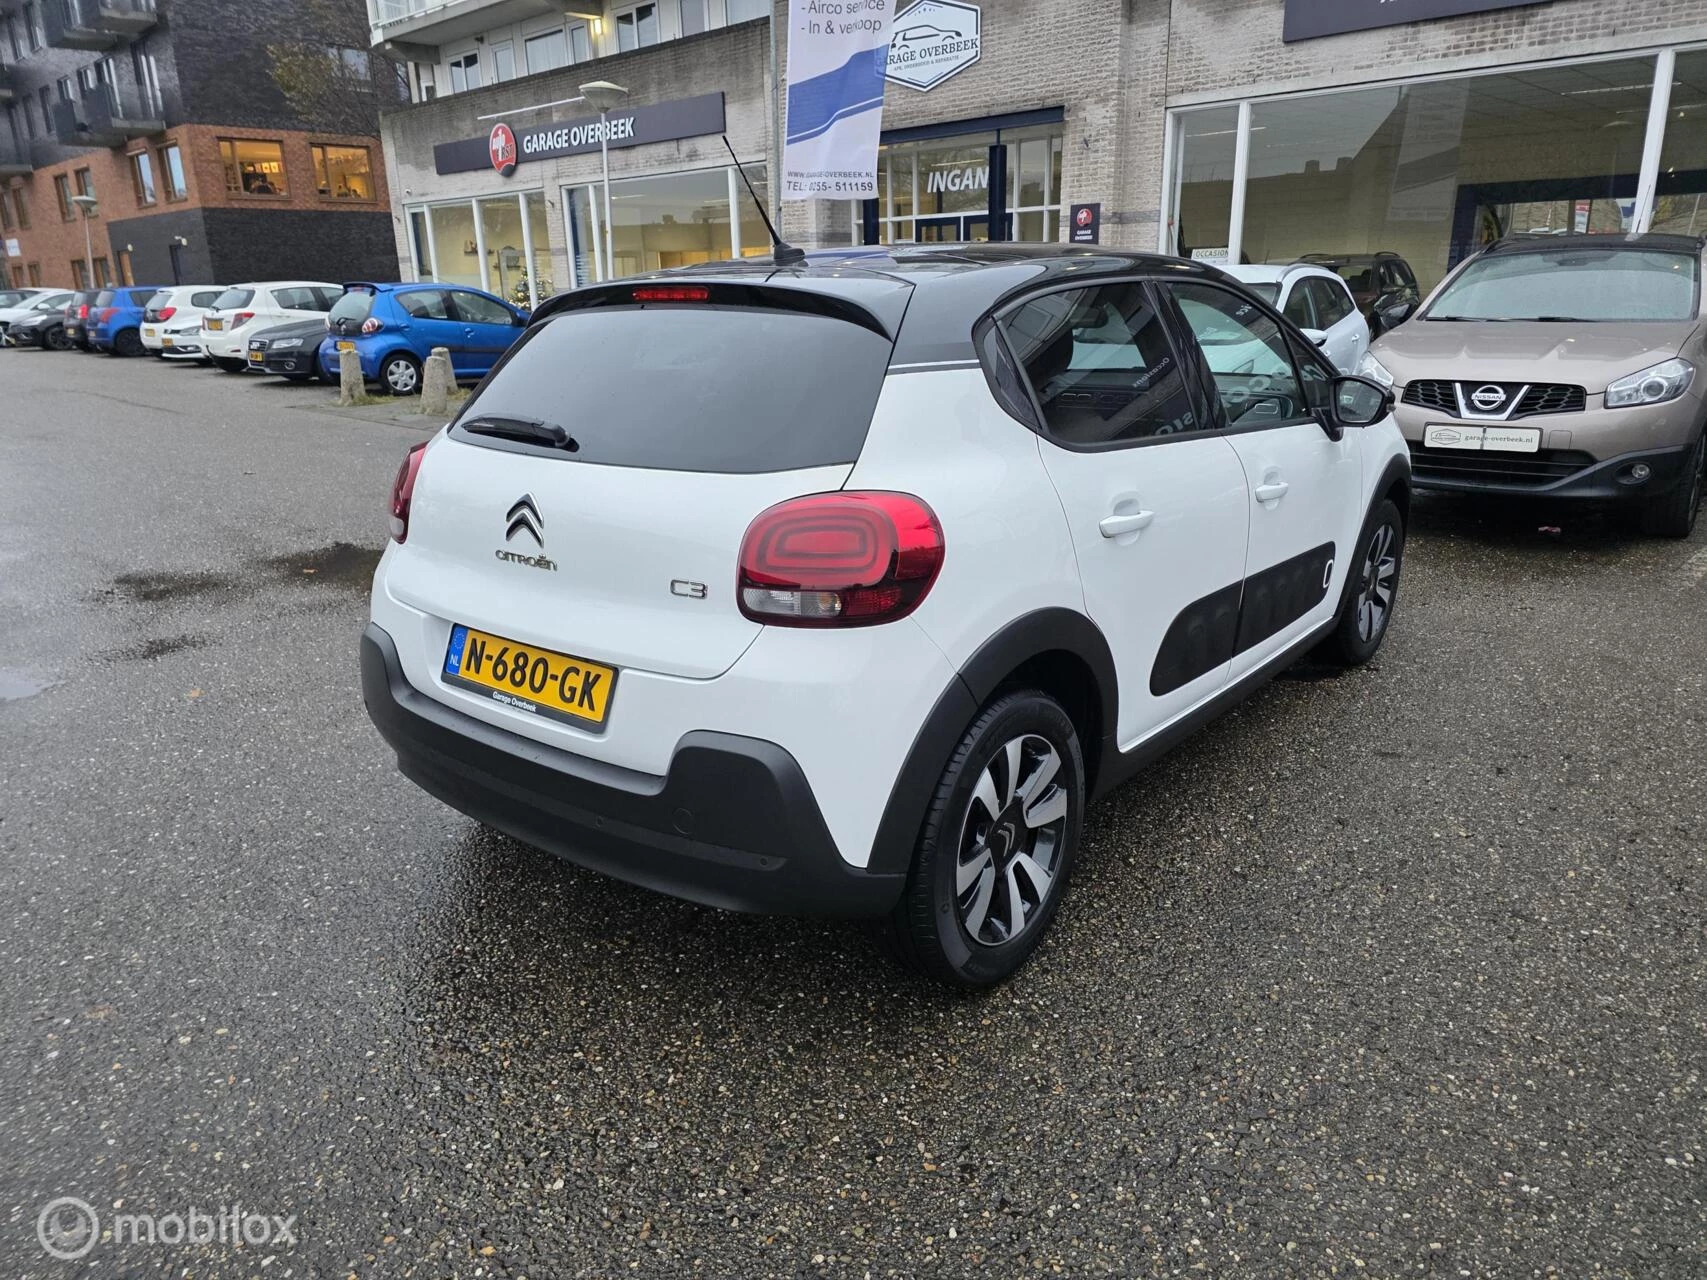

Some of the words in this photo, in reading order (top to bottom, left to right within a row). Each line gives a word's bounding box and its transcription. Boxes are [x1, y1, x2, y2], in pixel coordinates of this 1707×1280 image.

[808, 0, 842, 14] Airco
[809, 20, 820, 34] In
[824, 20, 834, 34] &
[887, 50, 917, 65] RAGE
[919, 38, 979, 59] OVERBEEK
[523, 128, 569, 154] GARAGE
[571, 117, 635, 146] OVERBEEK
[835, 182, 874, 191] 511159
[927, 166, 989, 193] INGAN
[670, 579, 709, 600] C3
[449, 654, 460, 667] NL
[465, 637, 602, 712] N-680-GK
[492, 691, 511, 705] Garage
[511, 697, 537, 712] Overbeek
